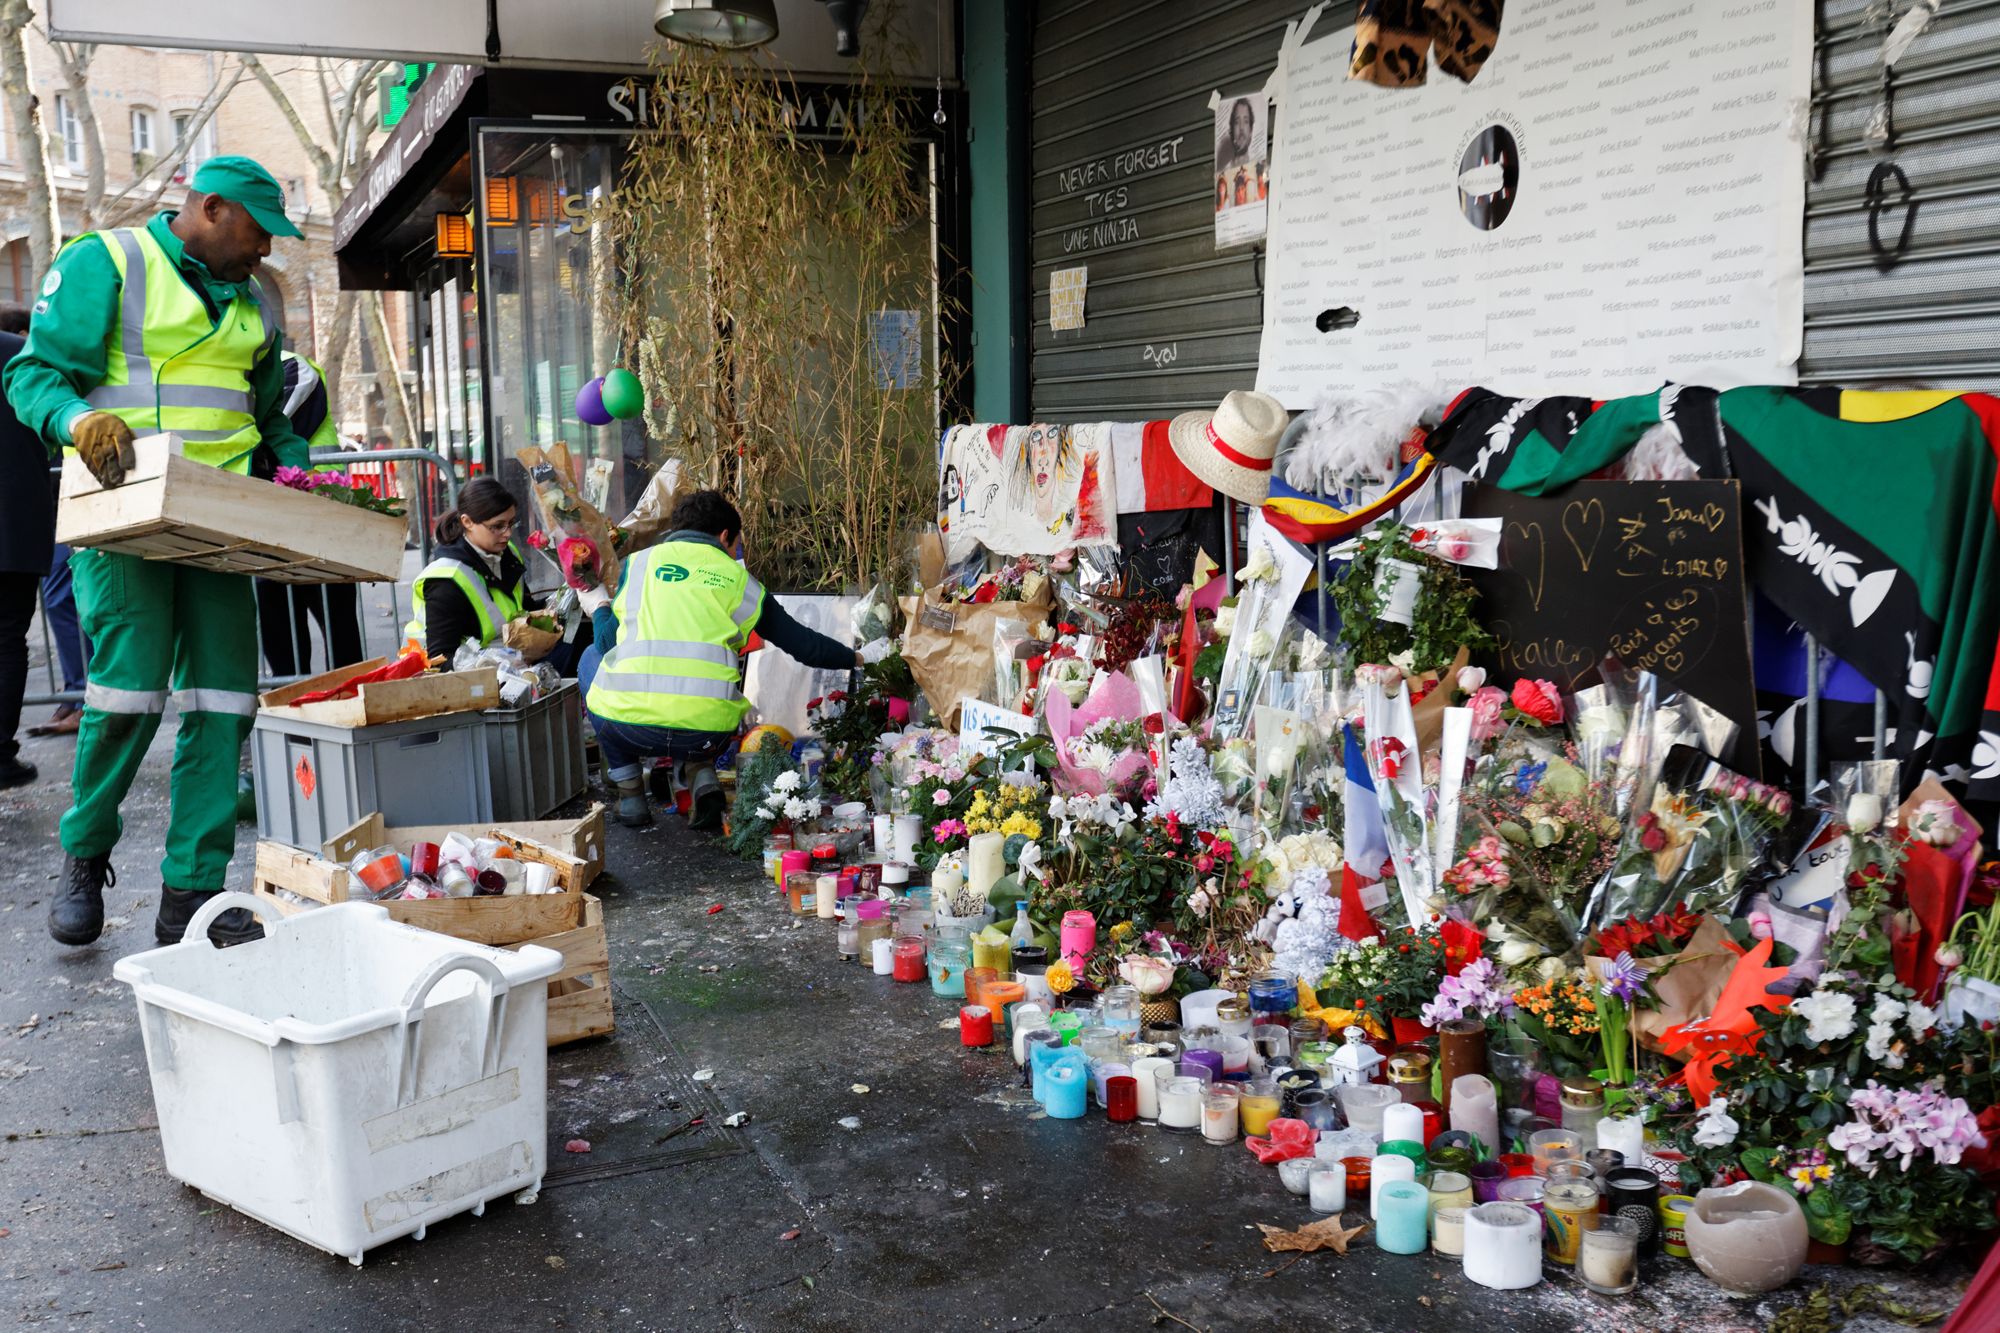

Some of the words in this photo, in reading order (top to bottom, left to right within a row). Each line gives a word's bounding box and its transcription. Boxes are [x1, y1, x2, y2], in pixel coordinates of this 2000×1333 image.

[1060, 160, 1110, 193] NEVER
[1115, 137, 1184, 178] FORGET
[1084, 187, 1129, 217] T'ES
[1063, 228, 1089, 252] UNE
[1093, 218, 1140, 247] NINJA
[1676, 559, 1714, 578] DIAZ
